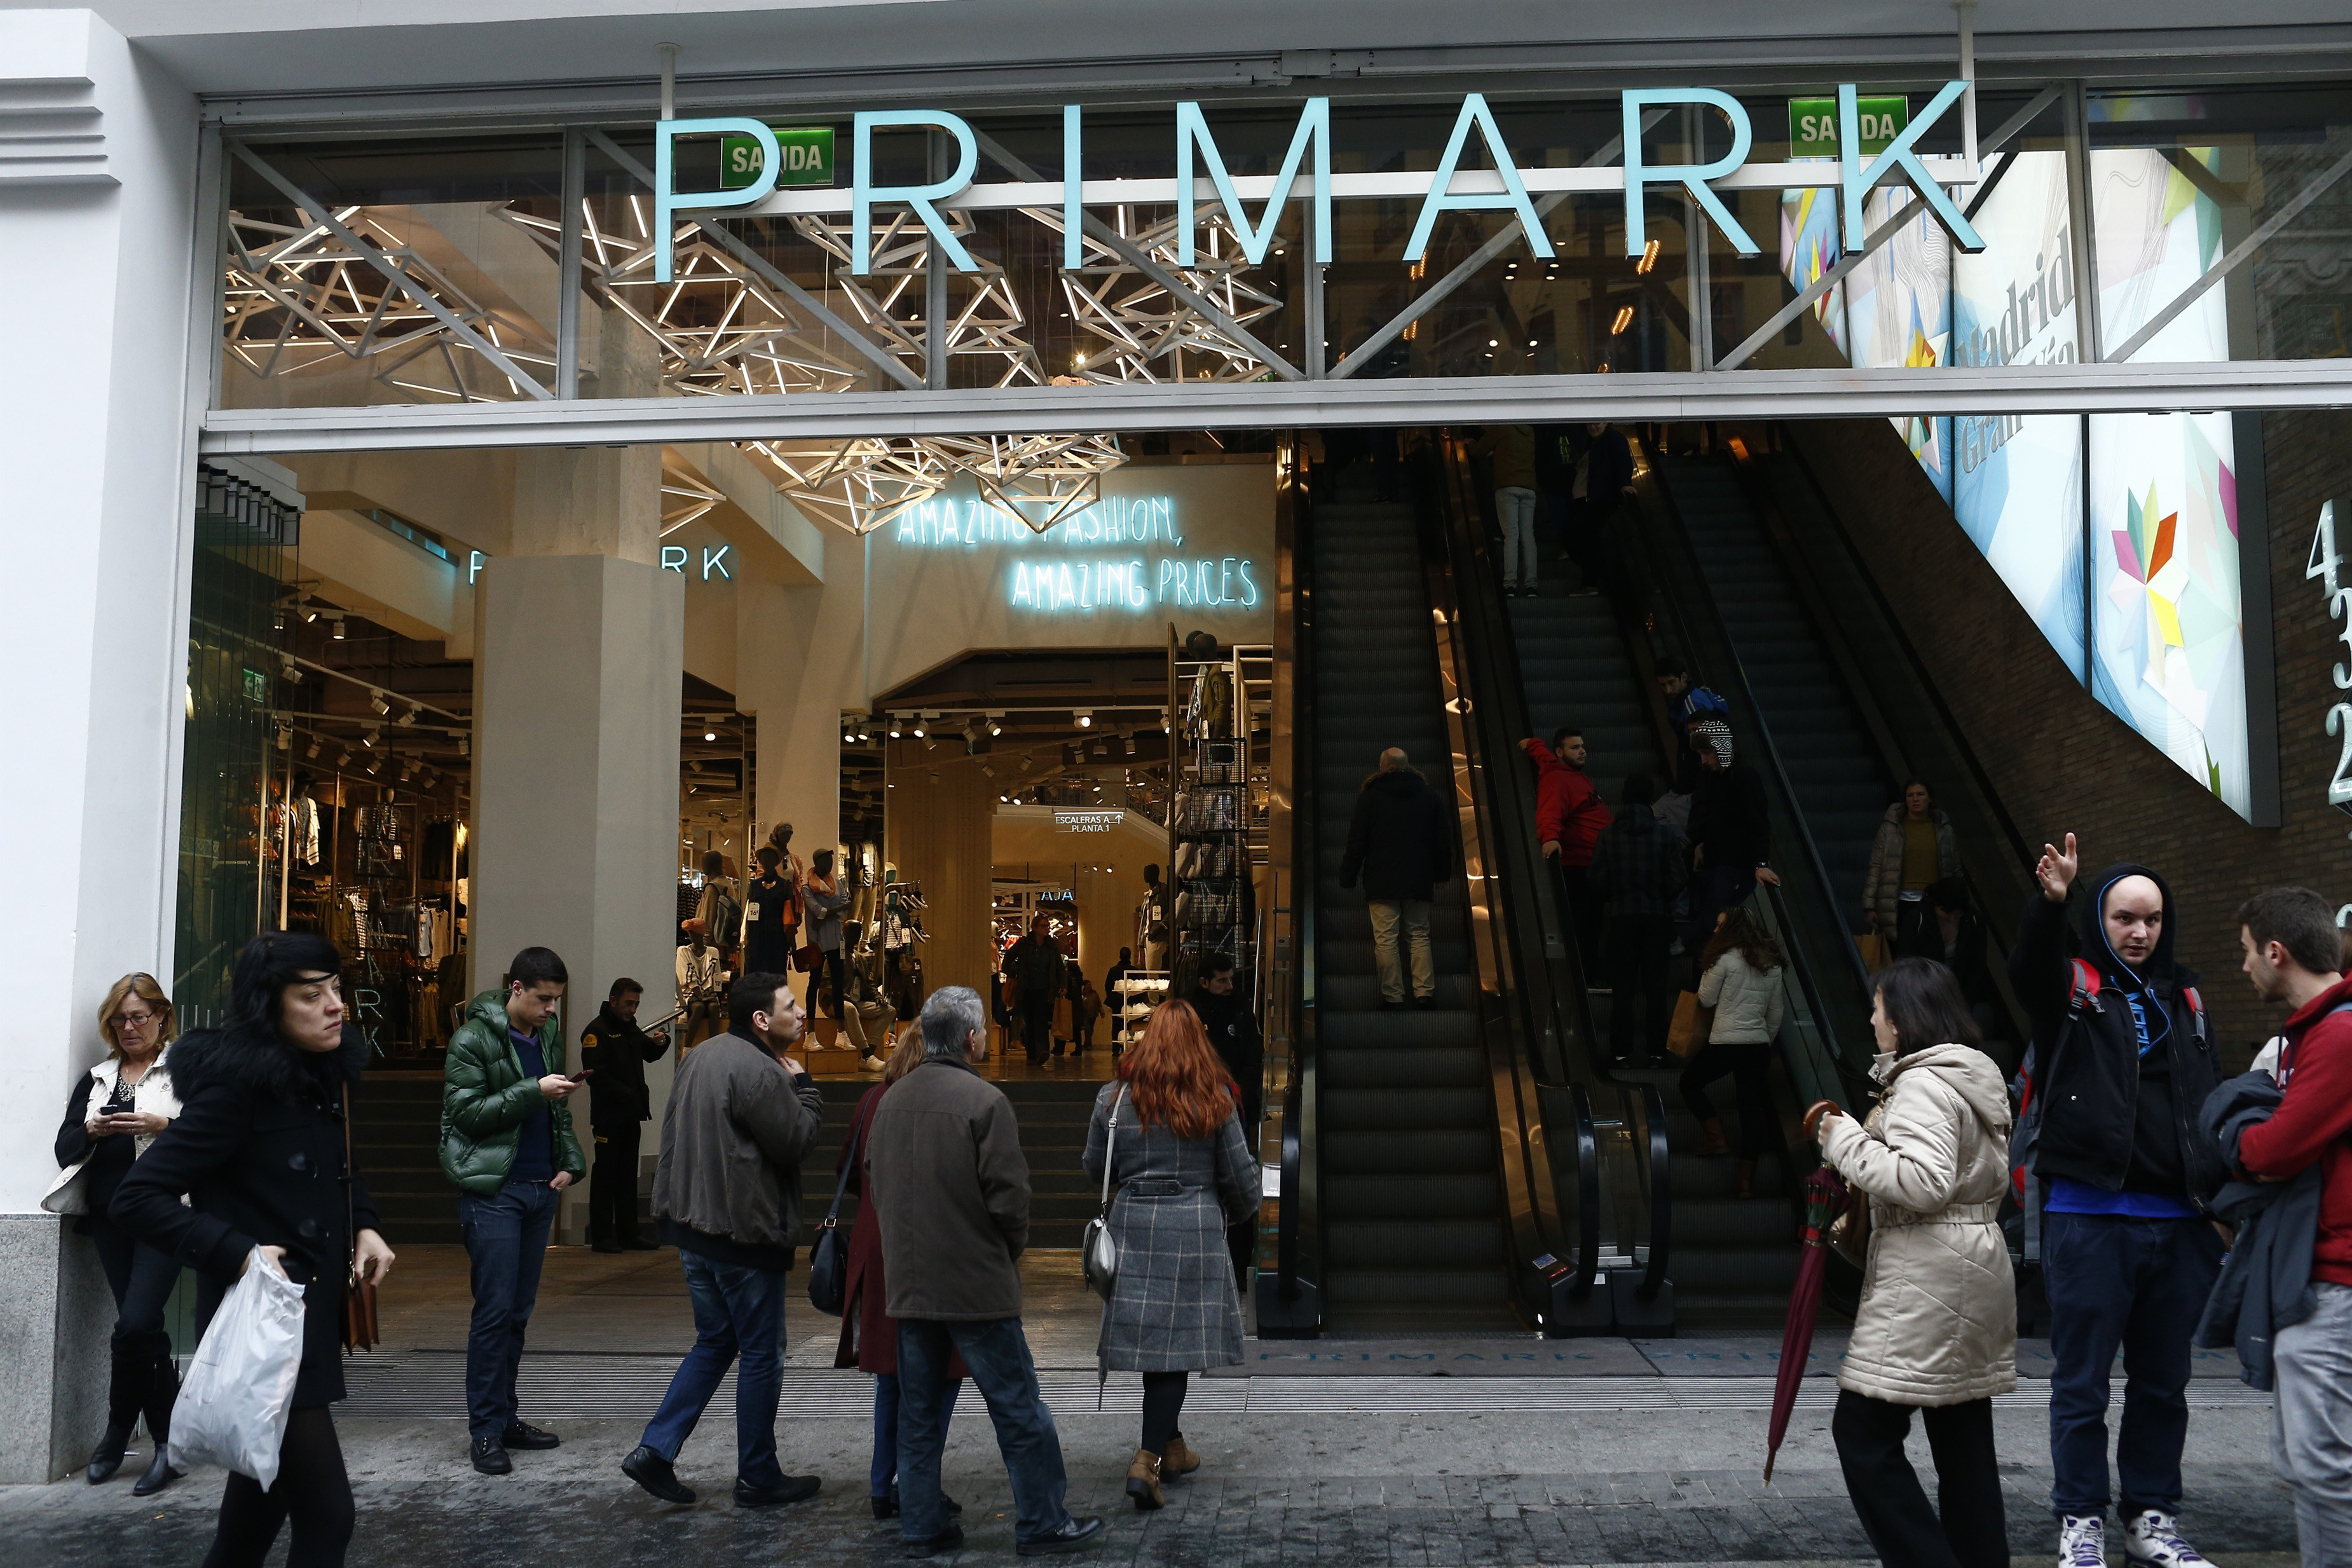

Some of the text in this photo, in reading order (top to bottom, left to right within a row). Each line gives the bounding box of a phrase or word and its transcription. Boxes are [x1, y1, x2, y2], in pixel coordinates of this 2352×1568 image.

[1800, 113, 1897, 142] SADA
[732, 144, 823, 173] SAIDA
[655, 79, 1986, 284] PRIMARK
[2306, 499, 2344, 601] 4
[1011, 557, 1257, 611] AMAZING PRICES
[1072, 824, 1103, 833] PLANTA
[1103, 815, 1109, 824] A
[1260, 1353, 1594, 1361] PRIMARK
